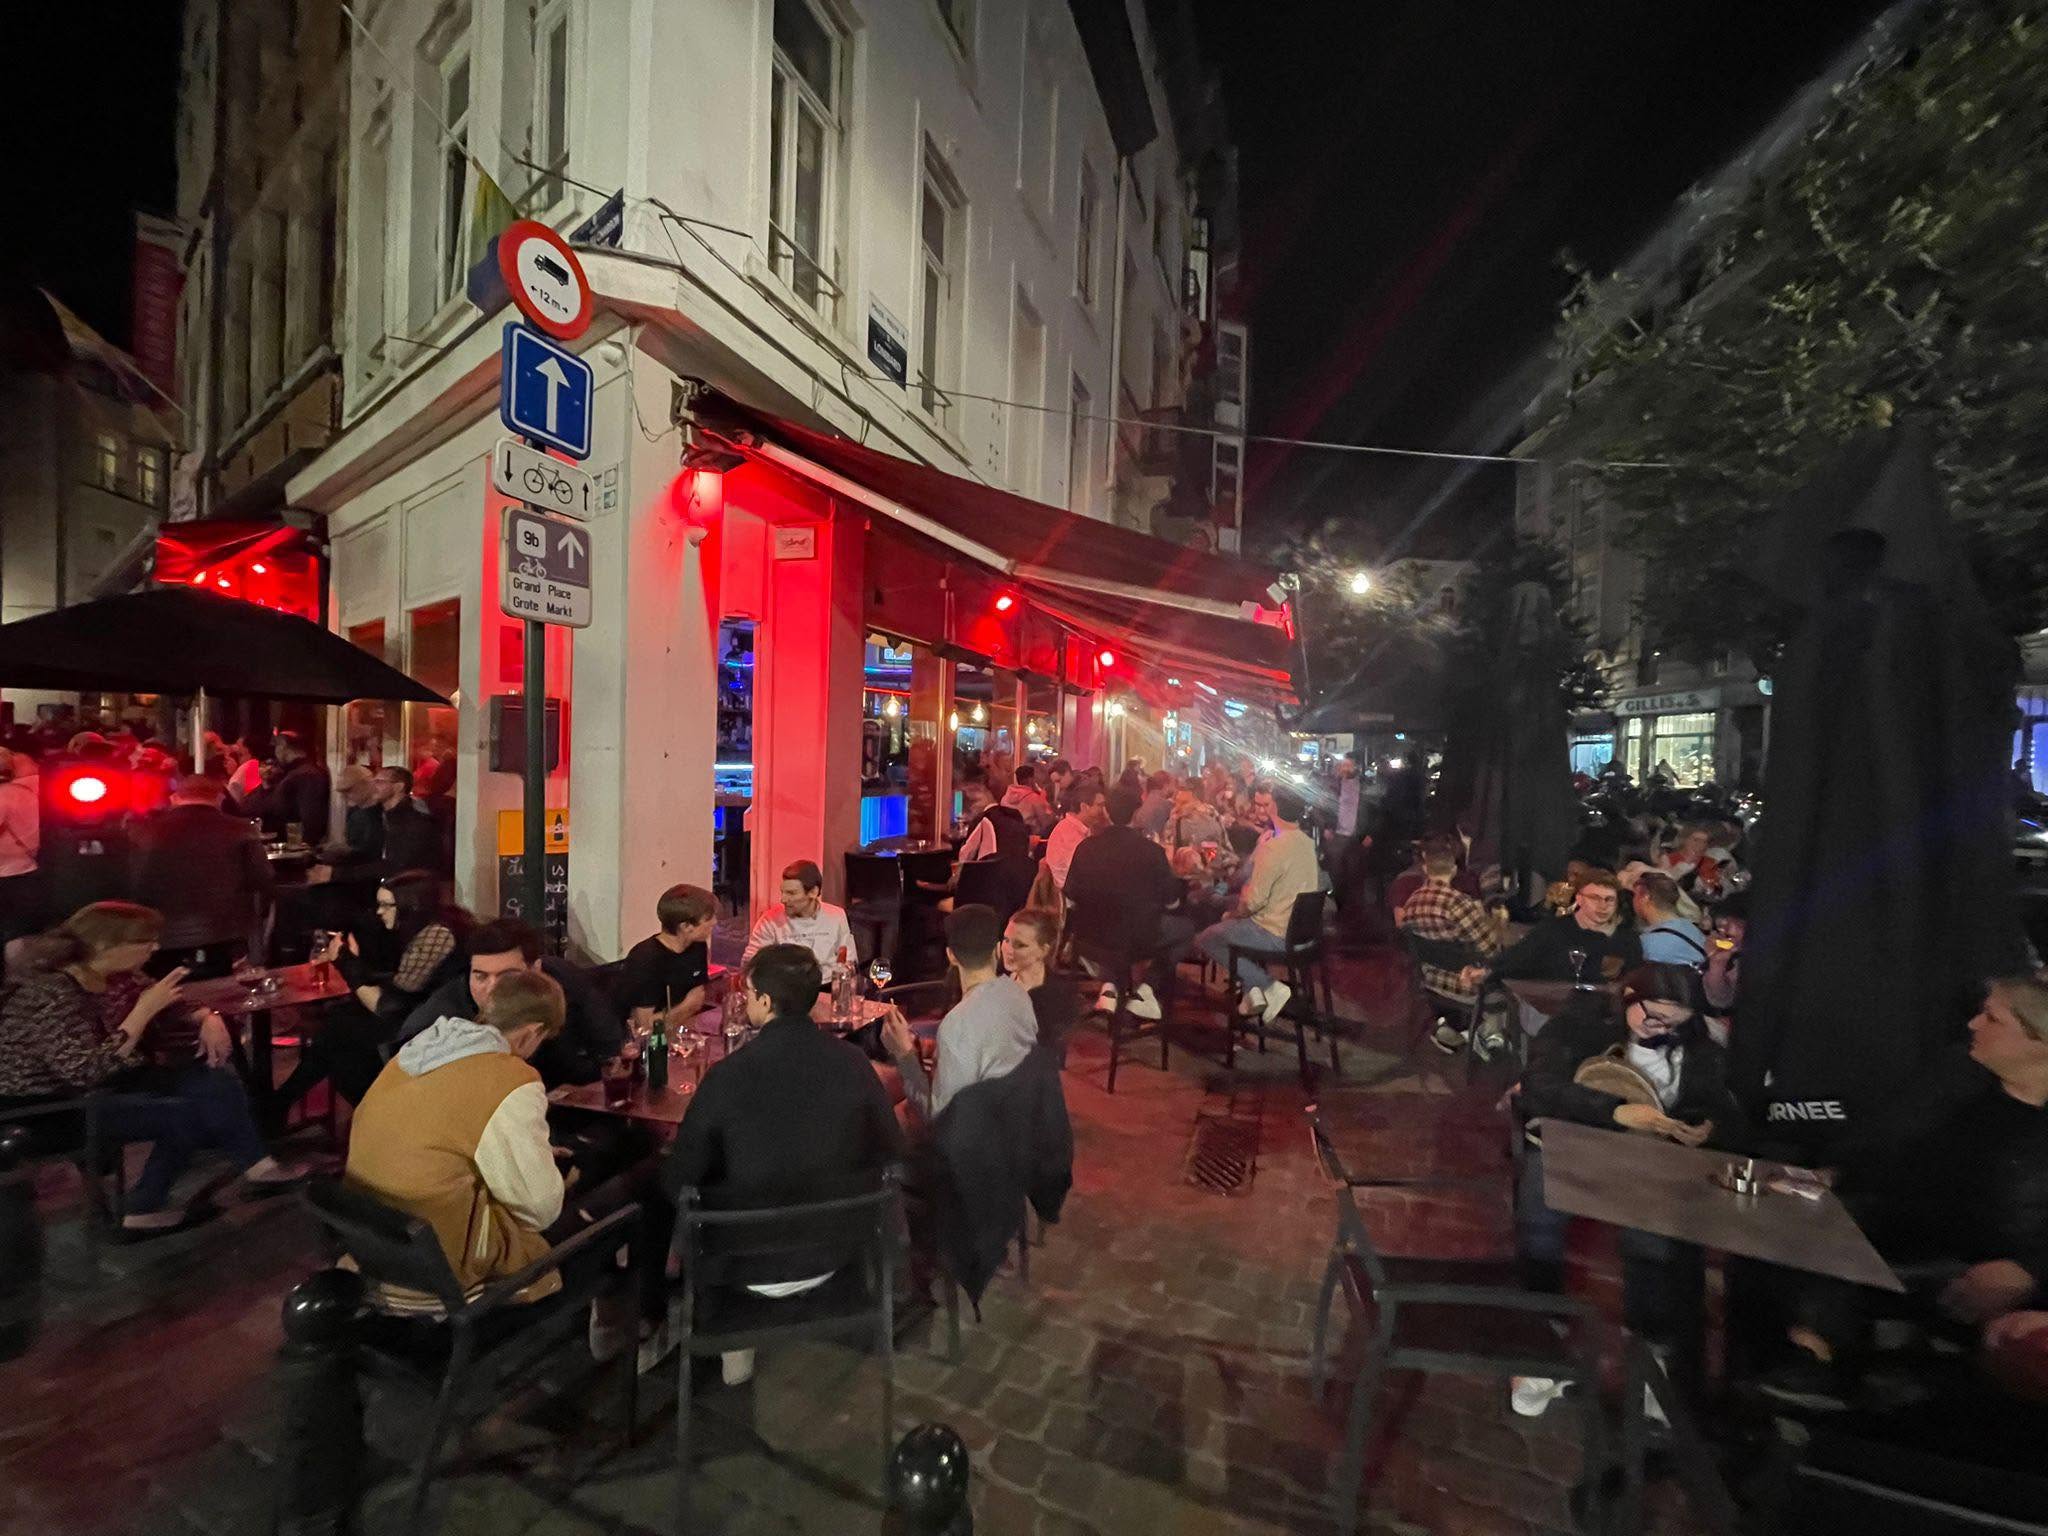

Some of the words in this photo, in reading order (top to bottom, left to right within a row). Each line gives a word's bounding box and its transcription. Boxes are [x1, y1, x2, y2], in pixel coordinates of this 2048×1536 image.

[540, 288, 550, 304] 12
[551, 299, 561, 311] m
[523, 530, 540, 548] 9b
[512, 576, 541, 594] Grand
[547, 584, 572, 600] Place
[512, 596, 540, 612] Grote
[546, 602, 573, 618] Markt
